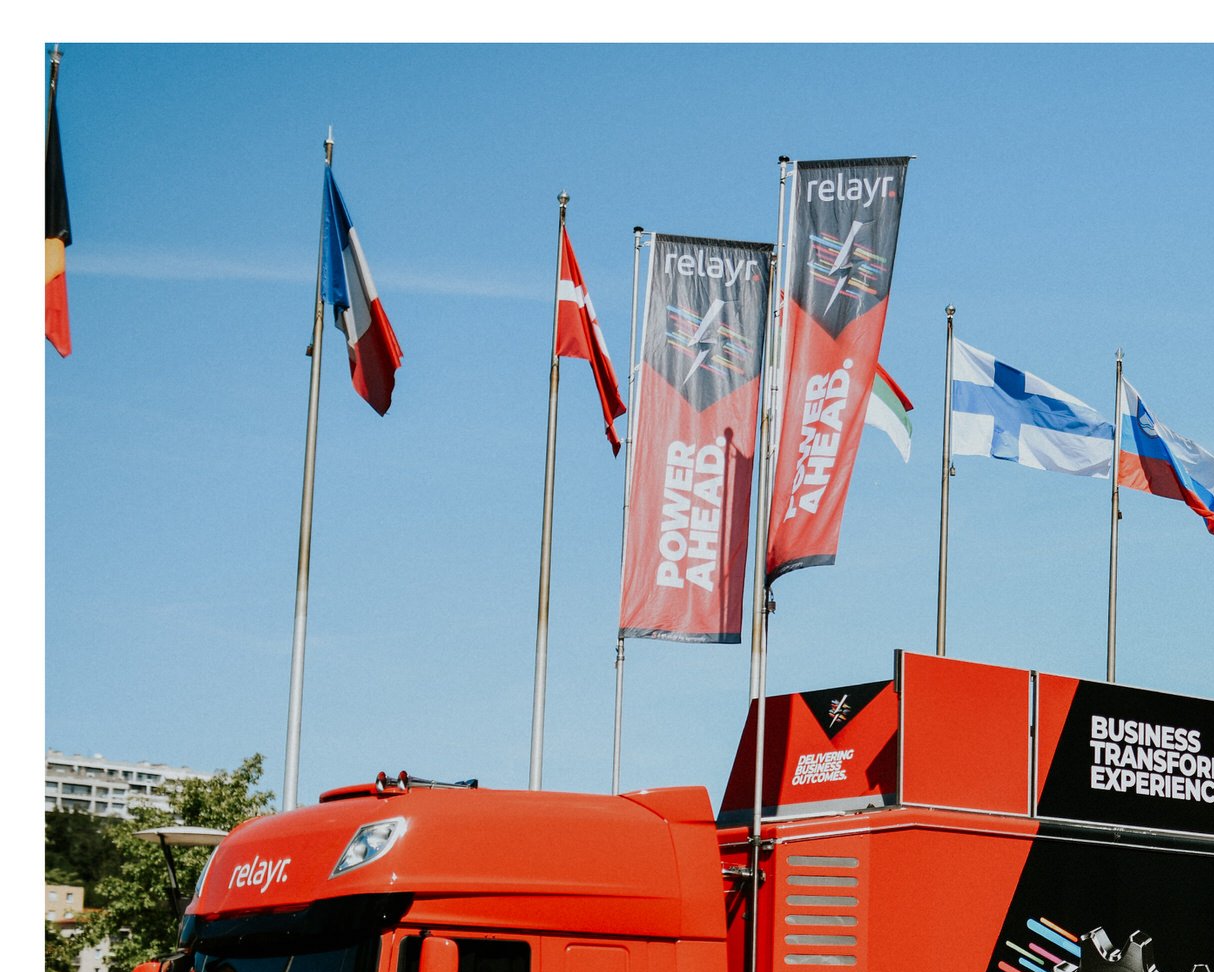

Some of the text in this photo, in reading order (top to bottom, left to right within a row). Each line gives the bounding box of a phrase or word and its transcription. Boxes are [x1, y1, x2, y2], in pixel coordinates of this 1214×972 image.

[807, 173, 896, 208] relayr.
[664, 250, 760, 287] relayr.
[799, 357, 854, 514] AHEAD.
[656, 440, 697, 589] POWER
[686, 436, 728, 592] AHEAD.
[1091, 715, 1201, 754] BUSINESS
[795, 760, 842, 776] BUSINESS
[798, 749, 855, 765] DELIVERING
[791, 770, 847, 785] OUTCOMES.
[228, 855, 291, 894] relayr.
